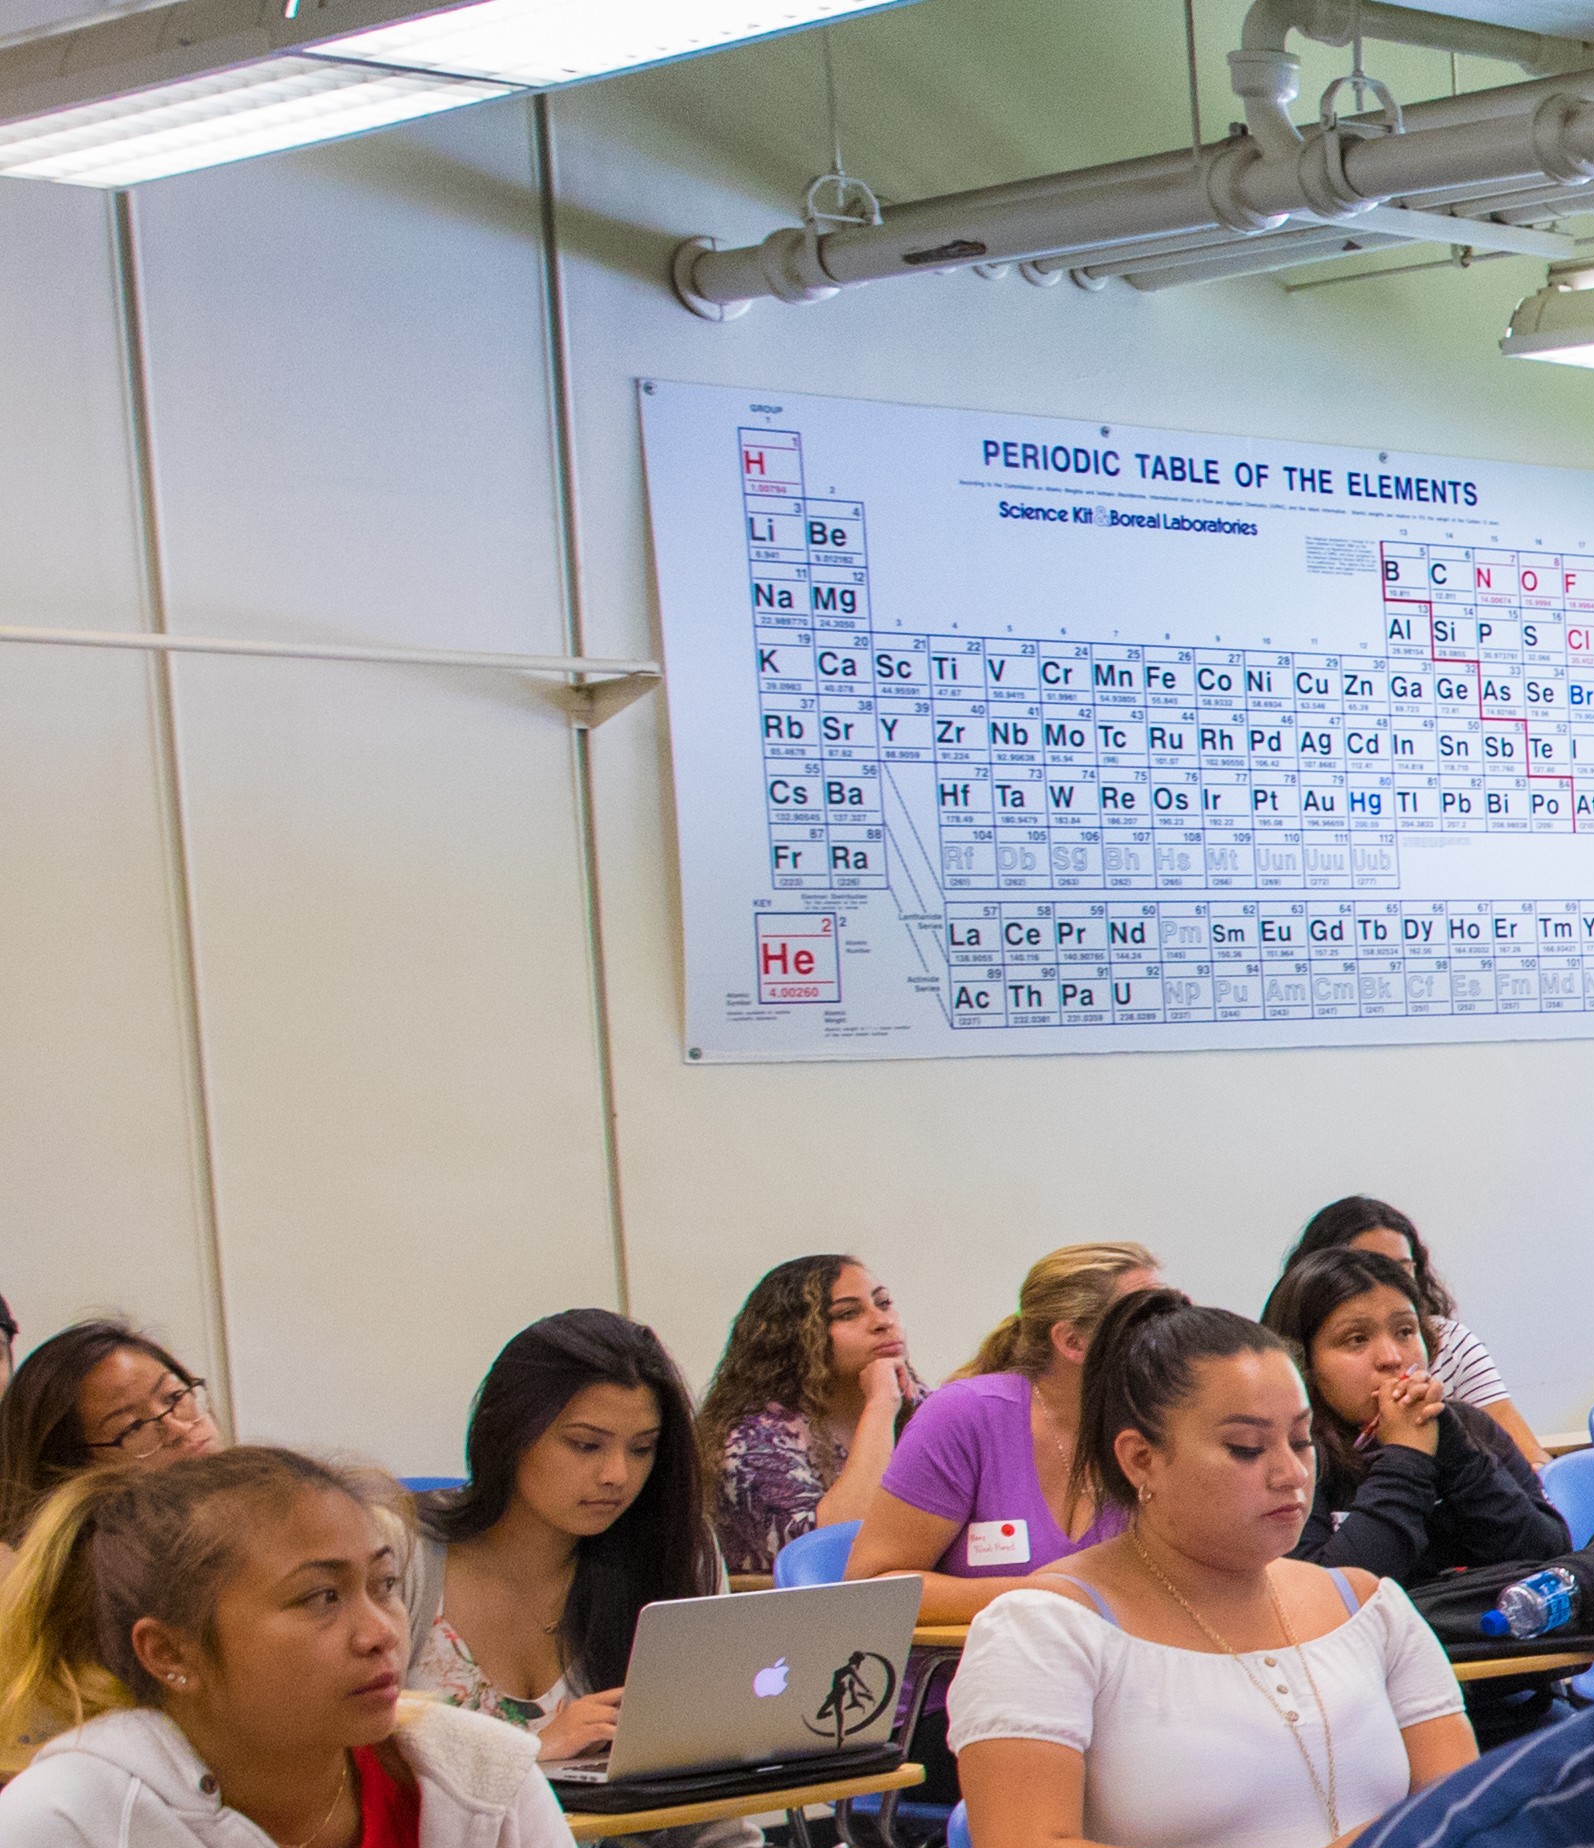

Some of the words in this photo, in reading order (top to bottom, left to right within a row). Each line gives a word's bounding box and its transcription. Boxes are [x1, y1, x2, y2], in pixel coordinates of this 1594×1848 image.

[744, 451, 766, 474] H
[983, 439, 1121, 477] PERIODIC
[1134, 453, 1220, 485] TABLE
[1234, 462, 1269, 488] OF
[1283, 466, 1334, 494] THE
[1347, 471, 1478, 506] ELEMENTS
[999, 501, 1068, 522] Science
[1073, 507, 1093, 524] Kit
[1110, 510, 1160, 529] Boreal
[1164, 514, 1258, 536] Laboratories
[749, 517, 775, 542] Li
[808, 521, 847, 547] Be
[1384, 560, 1400, 581] B
[1431, 563, 1447, 584] C
[1476, 568, 1491, 588] N
[1521, 571, 1538, 591] O
[1565, 573, 1576, 593] F
[754, 583, 793, 609] Na
[812, 586, 857, 614] Mg
[1389, 618, 1411, 640] Al
[1434, 620, 1455, 642] Si
[1479, 623, 1492, 643] P
[1523, 625, 1537, 646] S
[1568, 629, 1590, 650] Cl
[760, 649, 780, 673] K
[818, 651, 857, 676] Ca
[876, 654, 912, 679] Sc
[932, 656, 957, 680] Ti
[988, 659, 1005, 682] V
[1041, 661, 1072, 685] Cr
[1095, 664, 1132, 687] Mn
[1146, 666, 1176, 689] Fe
[1197, 668, 1232, 691] Co
[1247, 670, 1271, 692] Ni
[1296, 672, 1328, 695] Cu
[1344, 675, 1373, 697] Zn
[1390, 676, 1422, 698] Ga
[1436, 677, 1468, 699] Ge
[1483, 680, 1511, 701] As
[1527, 682, 1554, 703] Se
[1570, 684, 1593, 705] Br
[764, 714, 804, 739] Rb
[823, 716, 854, 740] Sr
[881, 718, 898, 742] Y
[936, 721, 965, 743] Zr
[991, 722, 1028, 745] Nb
[1045, 724, 1084, 747] Mo
[1098, 725, 1126, 747] Tc
[1150, 727, 1183, 750] Ru
[1201, 729, 1233, 750] Rh
[1250, 730, 1281, 751] Pd
[1301, 731, 1331, 755] Ag
[1347, 733, 1378, 754] Cd
[1393, 734, 1413, 755] In
[1440, 736, 1468, 756] Sn
[1485, 737, 1514, 758] Sb
[1530, 738, 1553, 759] Te
[769, 780, 808, 805] Cs
[826, 782, 864, 805] Ba
[940, 784, 970, 807] Hf
[995, 785, 1025, 808] Ta
[1049, 786, 1074, 808] W
[1102, 787, 1135, 809] Re
[1154, 787, 1188, 810] Os
[1204, 789, 1221, 810] Ir
[1254, 789, 1278, 811] Pt
[1303, 791, 1334, 812] Au
[1350, 792, 1381, 815] Hg
[1397, 792, 1418, 812] Tl
[1442, 793, 1471, 814] Pb
[1488, 794, 1509, 814] Bi
[1532, 795, 1559, 815] Po
[774, 846, 801, 870] Fr
[832, 846, 868, 870] Ra
[950, 924, 981, 945] La
[1005, 923, 1040, 945] Ce
[1058, 923, 1086, 944] Pr
[1111, 922, 1145, 943] Nd
[1213, 925, 1244, 942] Sm
[1261, 921, 1291, 941] Eu
[1310, 920, 1343, 941] Gd
[1358, 920, 1387, 940] Tb
[1404, 920, 1433, 941] Dy
[1450, 919, 1480, 939] Ho
[1495, 919, 1517, 938] Er
[1539, 919, 1572, 938] Tm
[762, 943, 814, 975] He
[769, 987, 819, 998] 4.00260
[955, 987, 989, 1008] Ac
[1009, 985, 1041, 1007] Th
[1062, 985, 1094, 1005] Pa
[1115, 983, 1131, 1004] U
